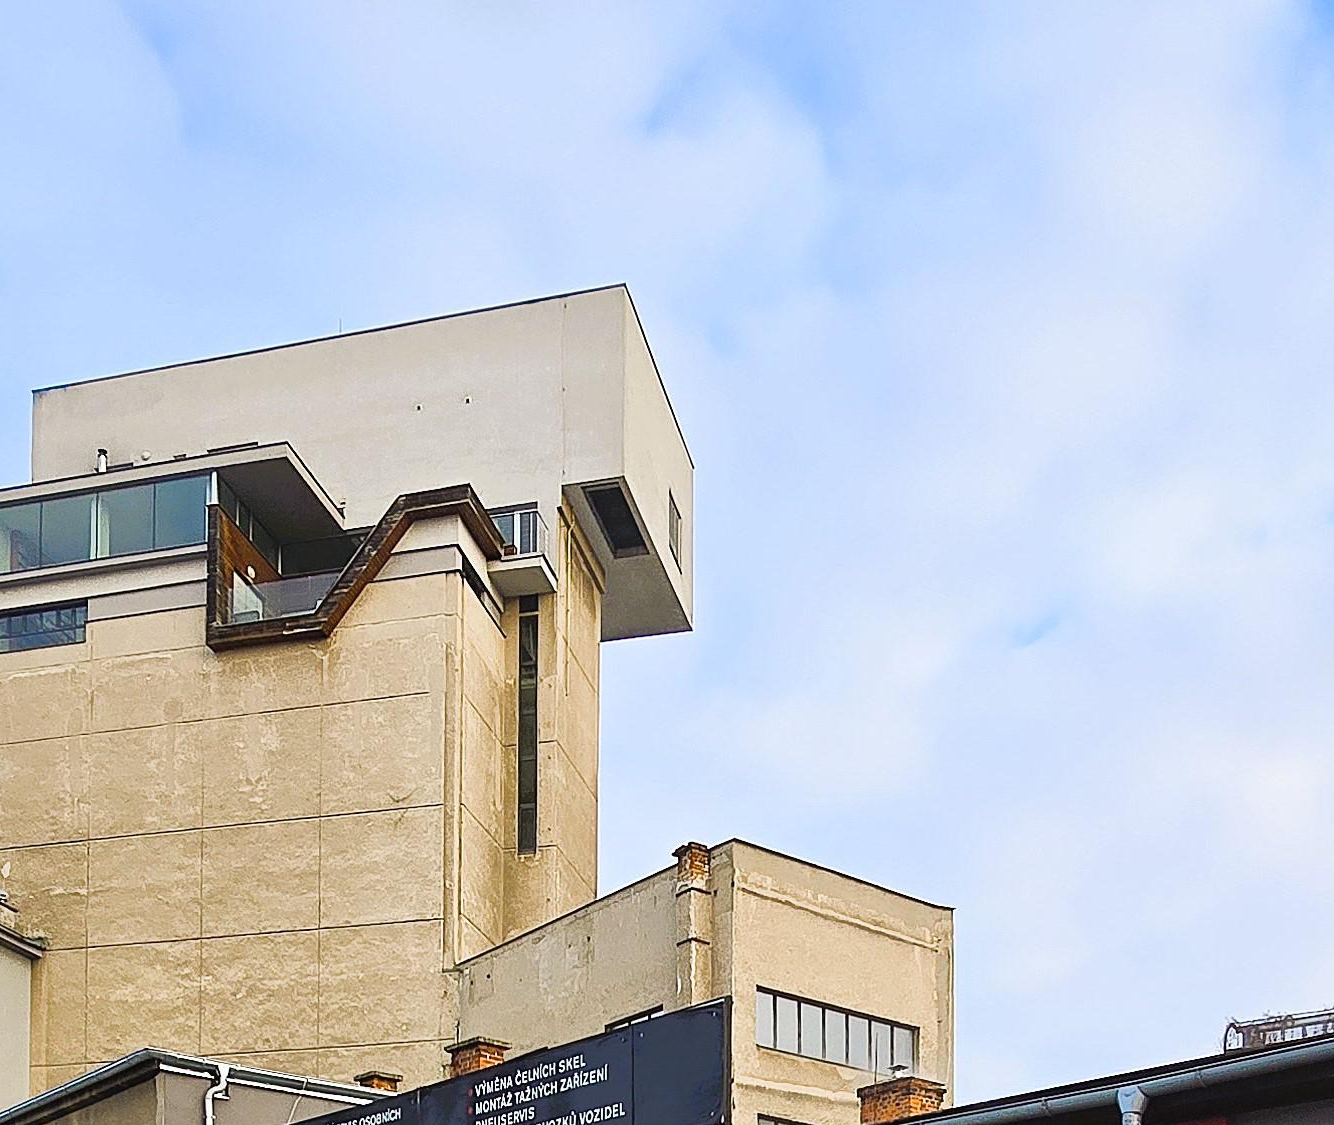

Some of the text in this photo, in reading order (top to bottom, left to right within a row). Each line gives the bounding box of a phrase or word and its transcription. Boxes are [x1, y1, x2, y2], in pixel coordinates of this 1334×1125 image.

[475, 1054, 586, 1096] VÝMĚNA ČELNÍCH SKEL
[476, 1064, 608, 1115] MONTÁŽ TAŽNÝCH ZAŘÍZENÍ
[579, 1103, 625, 1125] VOZIDEL
